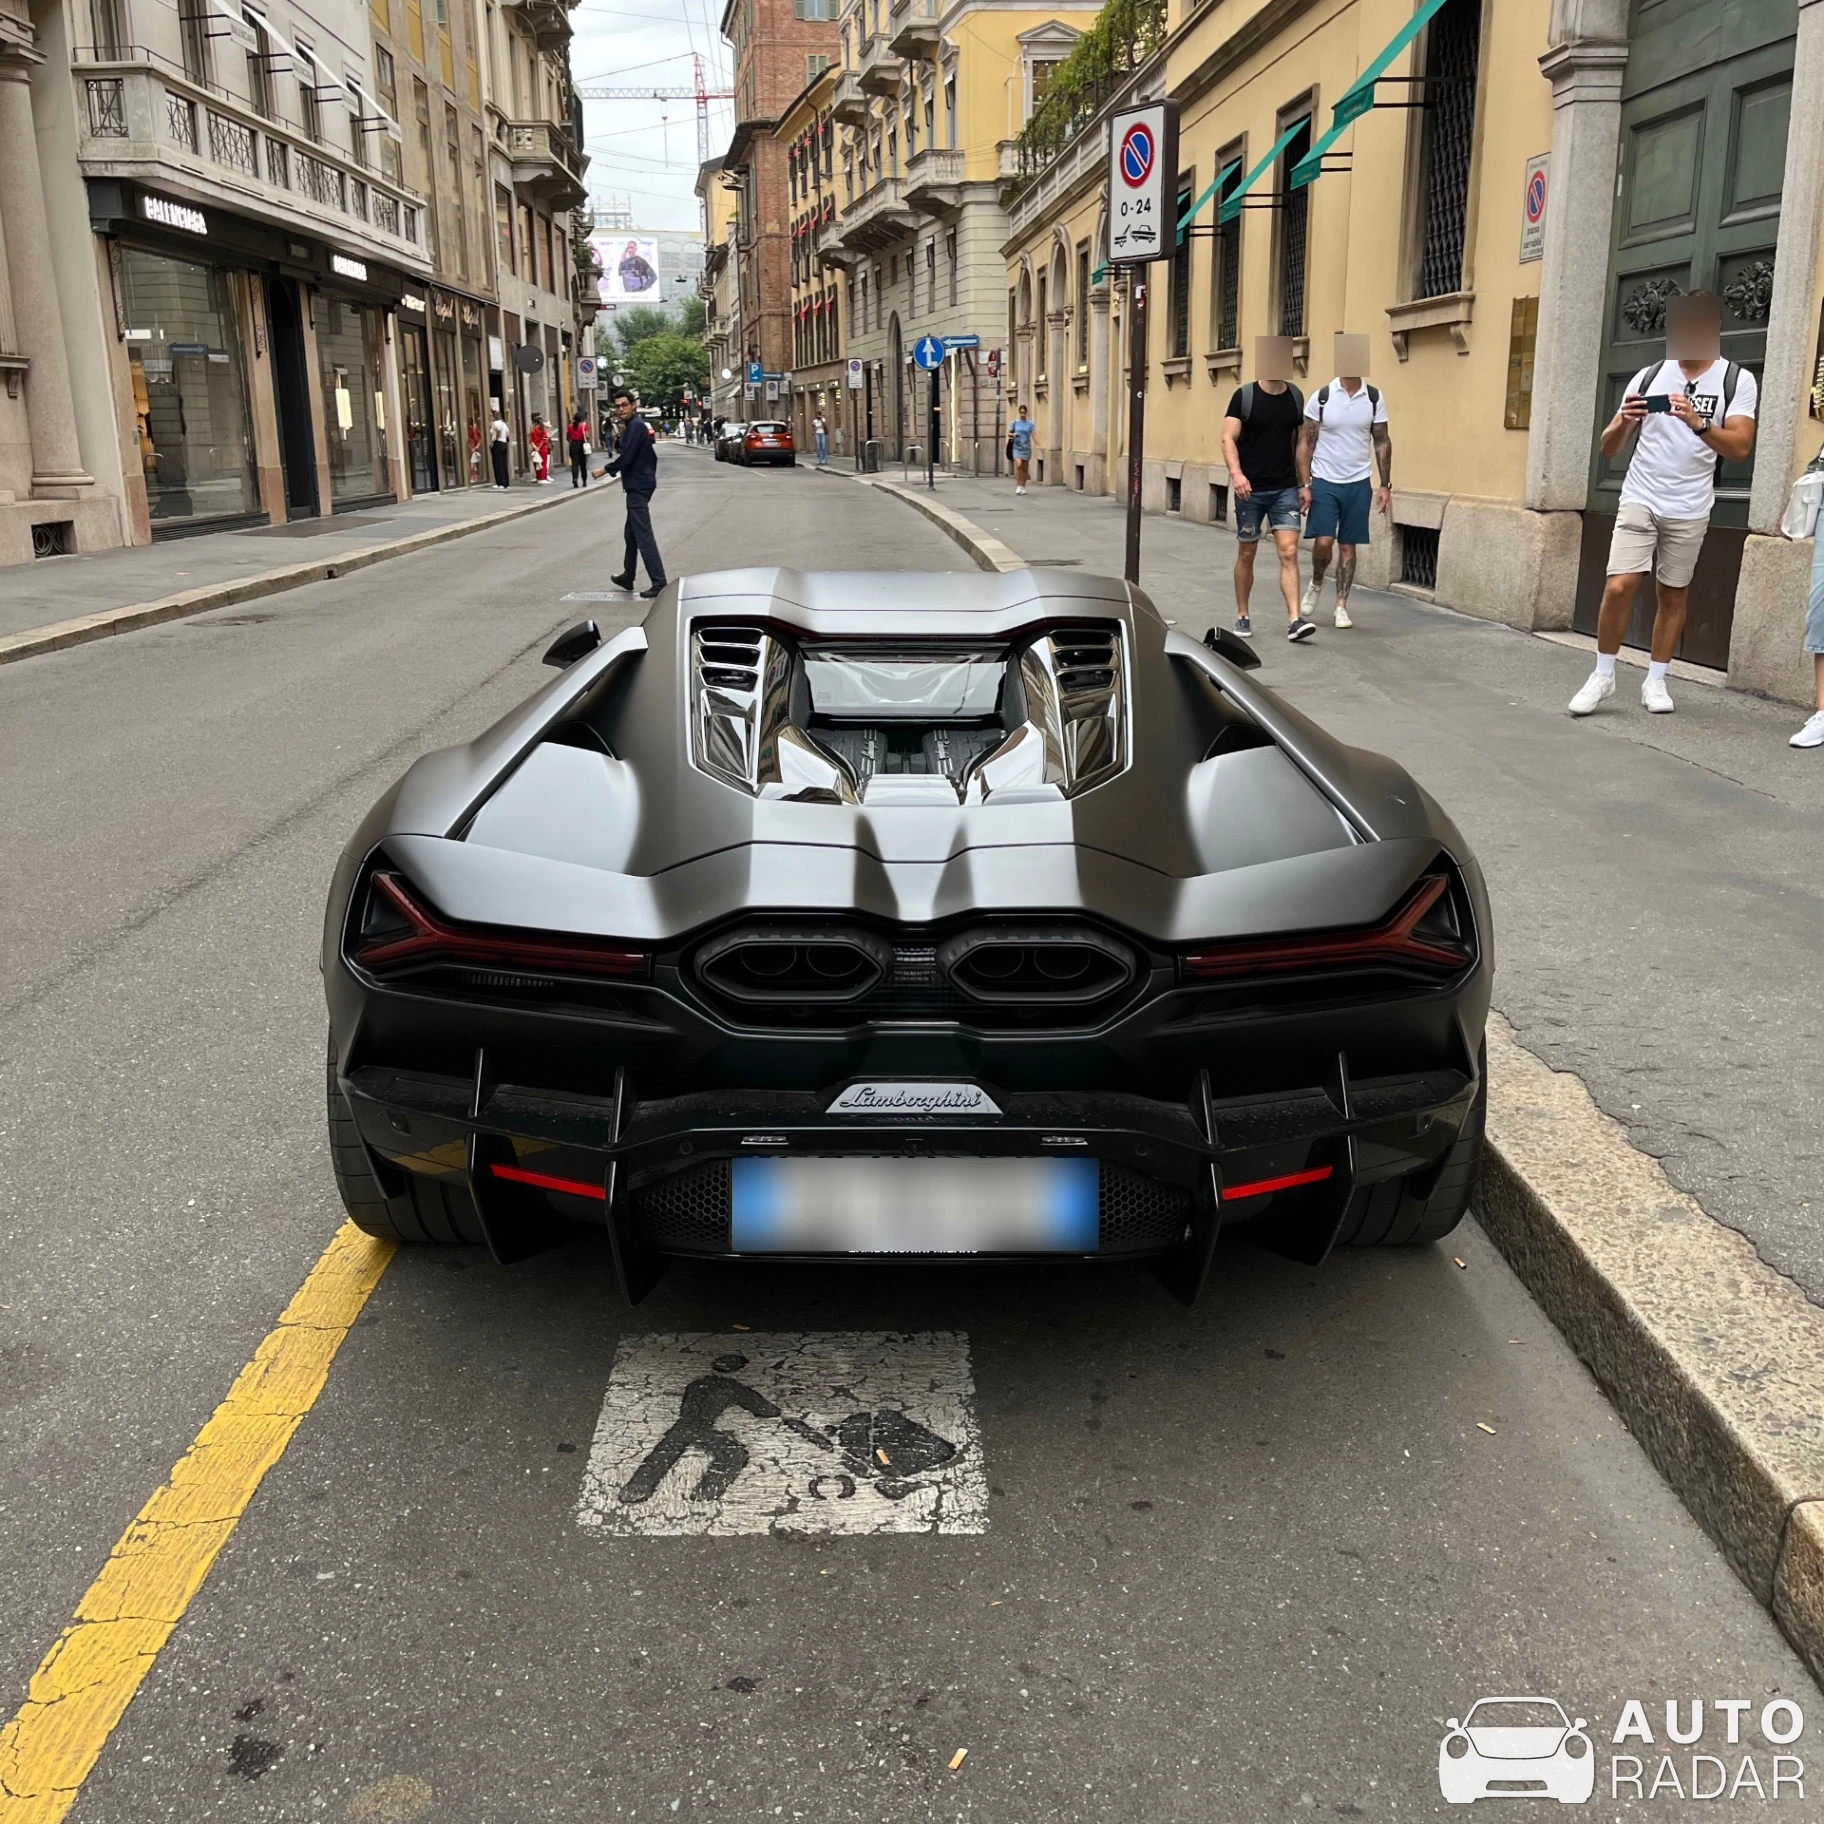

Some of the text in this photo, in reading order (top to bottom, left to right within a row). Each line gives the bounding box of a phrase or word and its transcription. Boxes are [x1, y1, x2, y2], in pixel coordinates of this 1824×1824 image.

[144, 195, 208, 235] BALENCIAGA
[751, 364, 759, 374] P
[839, 1086, 983, 1112] Lamborghini
